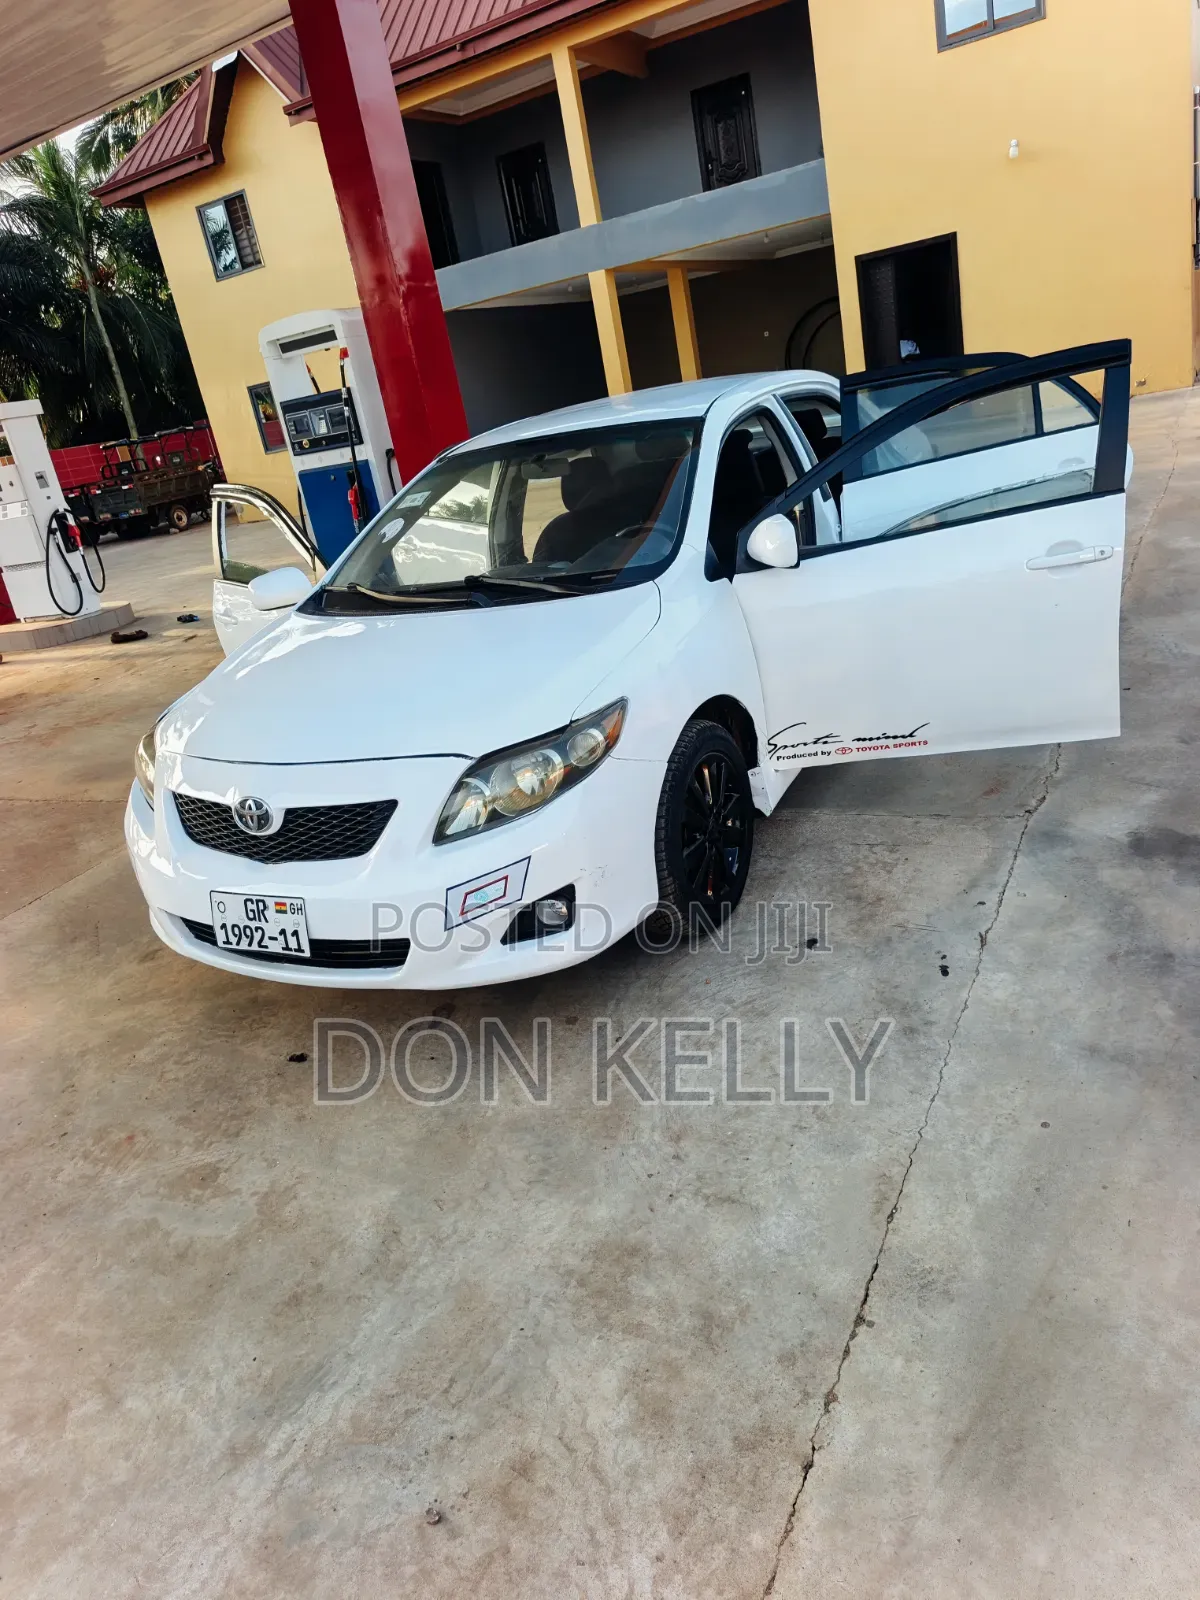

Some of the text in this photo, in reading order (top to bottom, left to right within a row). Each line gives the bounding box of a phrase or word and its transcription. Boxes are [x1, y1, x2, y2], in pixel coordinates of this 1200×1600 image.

[851, 722, 931, 743] mind
[776, 739, 929, 762] Produced by TOYOTA SPORTS
[243, 898, 304, 923] GR GH
[220, 923, 305, 954] 1992-11
